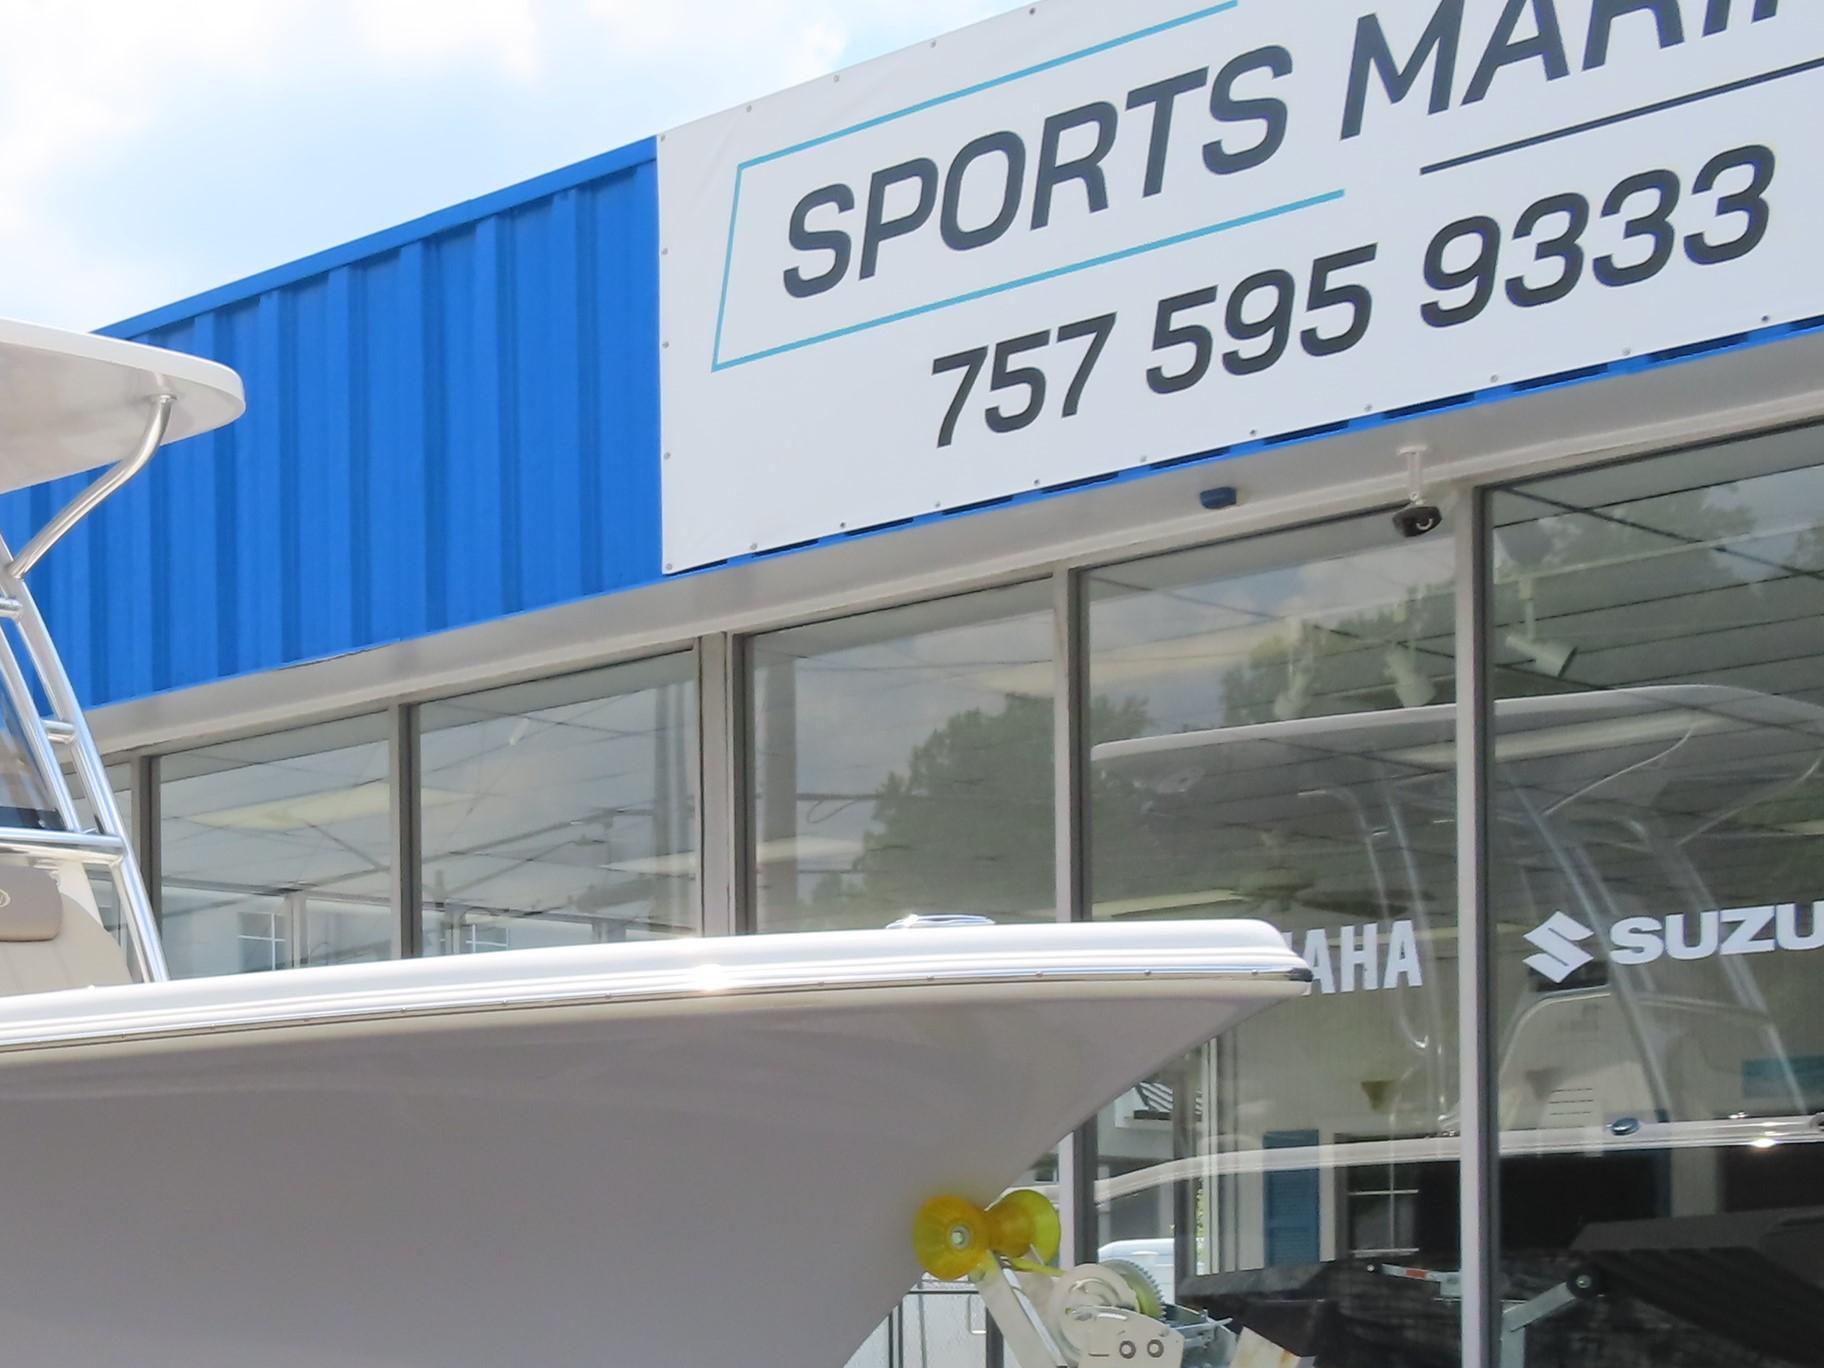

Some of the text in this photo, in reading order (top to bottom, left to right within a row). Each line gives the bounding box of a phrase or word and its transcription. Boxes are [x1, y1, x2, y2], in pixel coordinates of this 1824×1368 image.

[782, 0, 1778, 301] SPORTS MAR
[930, 143, 1777, 449] 757 595 9333
[1280, 919, 1424, 995] AHA
[1609, 899, 1824, 966] SUZU
